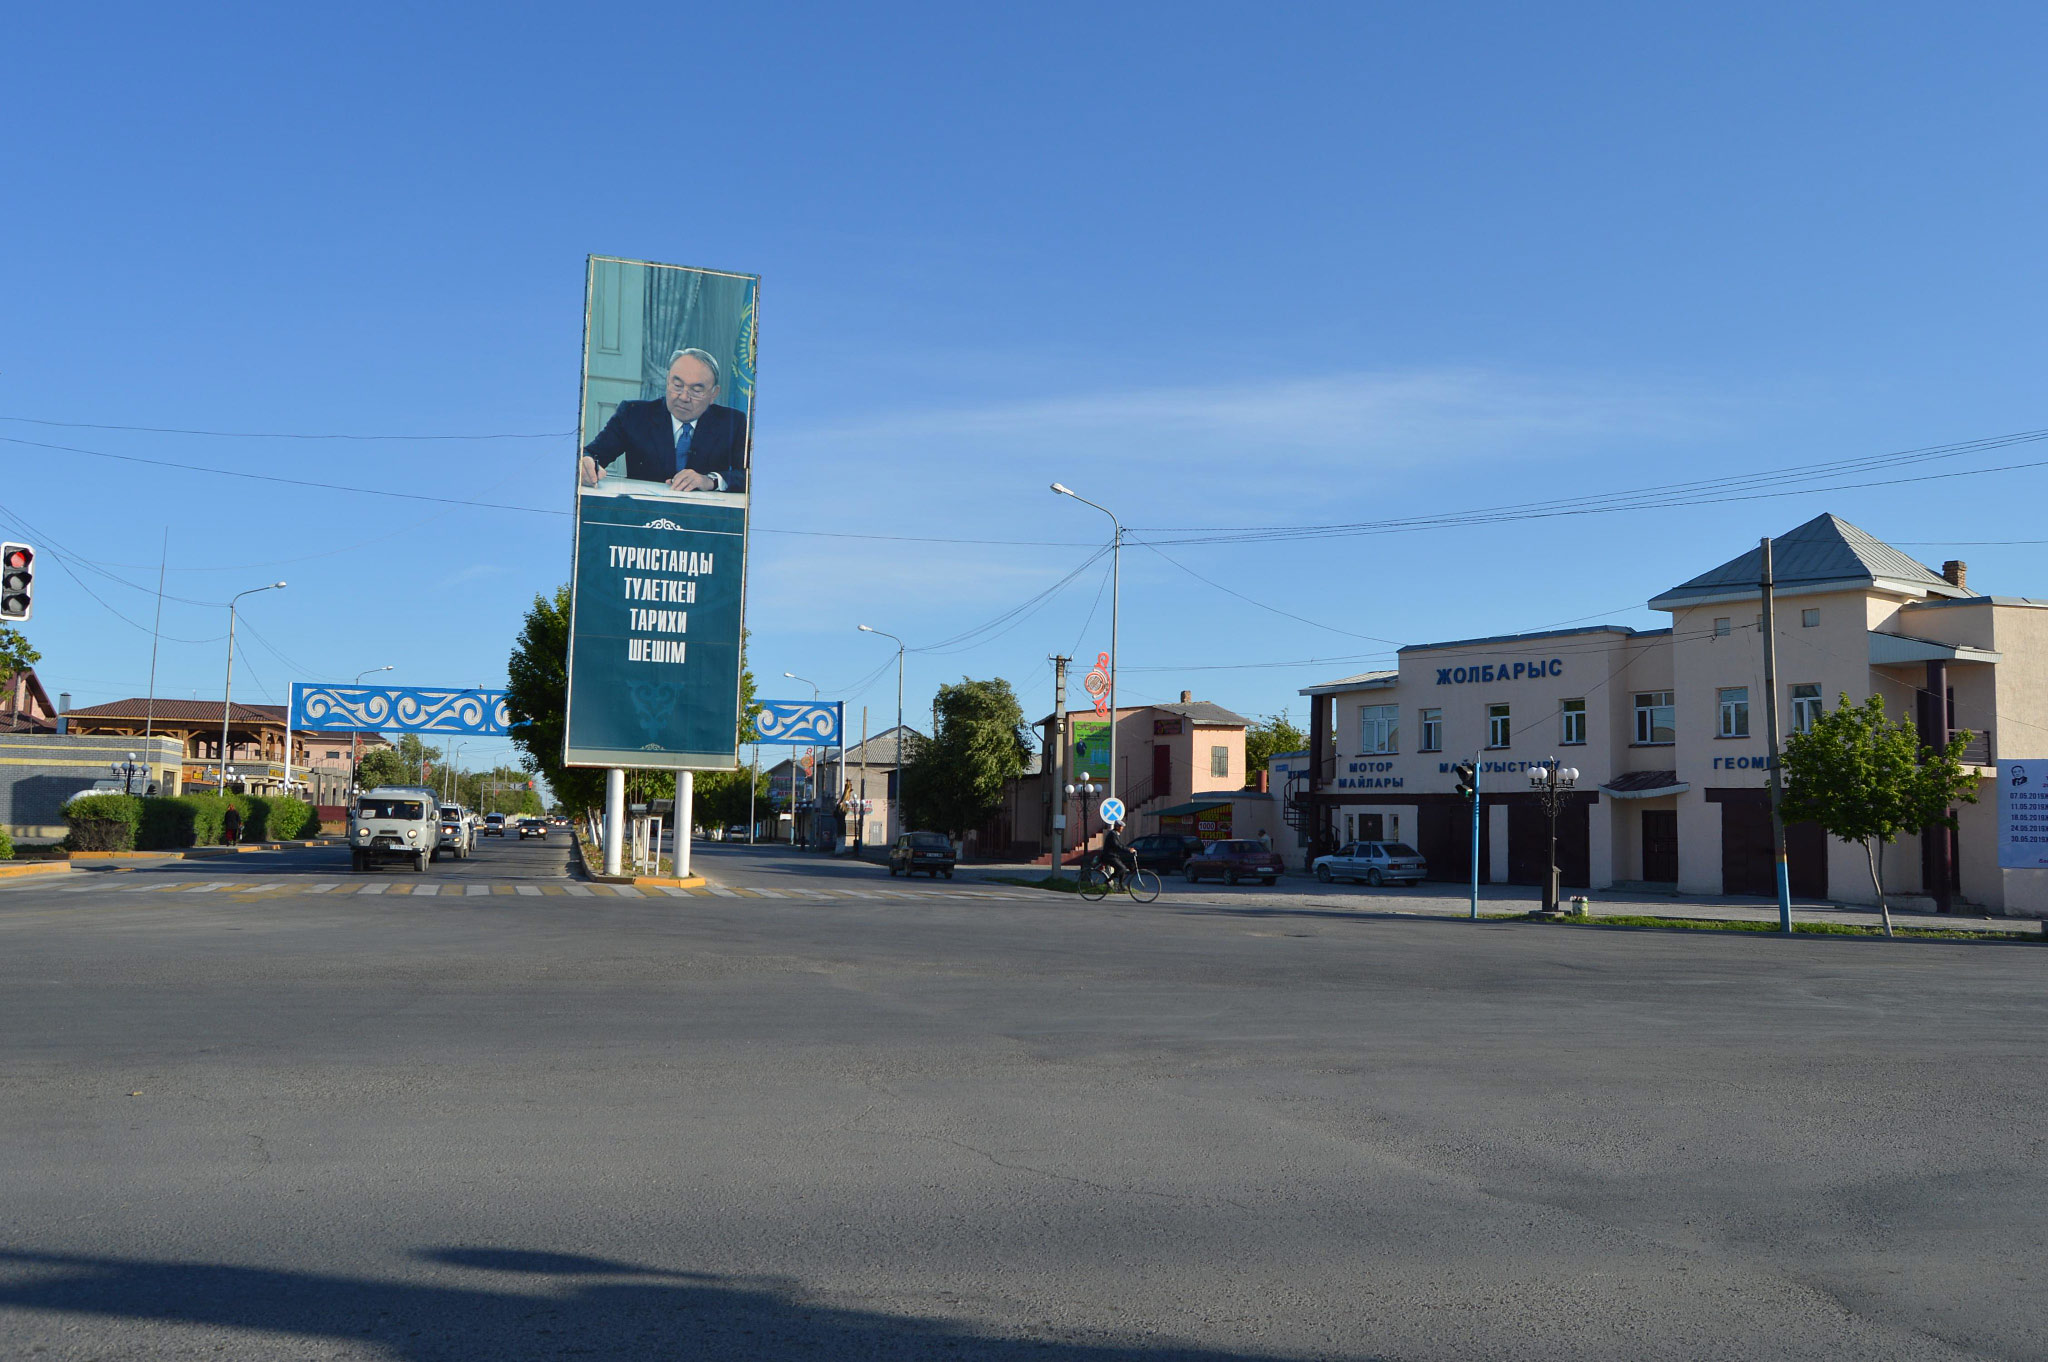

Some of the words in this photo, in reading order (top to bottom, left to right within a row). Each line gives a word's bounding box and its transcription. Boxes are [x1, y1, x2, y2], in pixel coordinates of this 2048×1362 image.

[609, 545, 714, 577] ТҮРКІСТАНДЫ
[624, 577, 696, 604] ТҮЛЕТКЕН
[629, 608, 688, 634] ТАРИХИ
[628, 638, 687, 664] ШЕШІМ
[1436, 658, 1563, 685] ЖОЛБАРЫС
[1349, 762, 1393, 773] МОТОР
[1338, 776, 1404, 788] МАЙЛАРЫ
[1199, 822, 1215, 830] 1000
